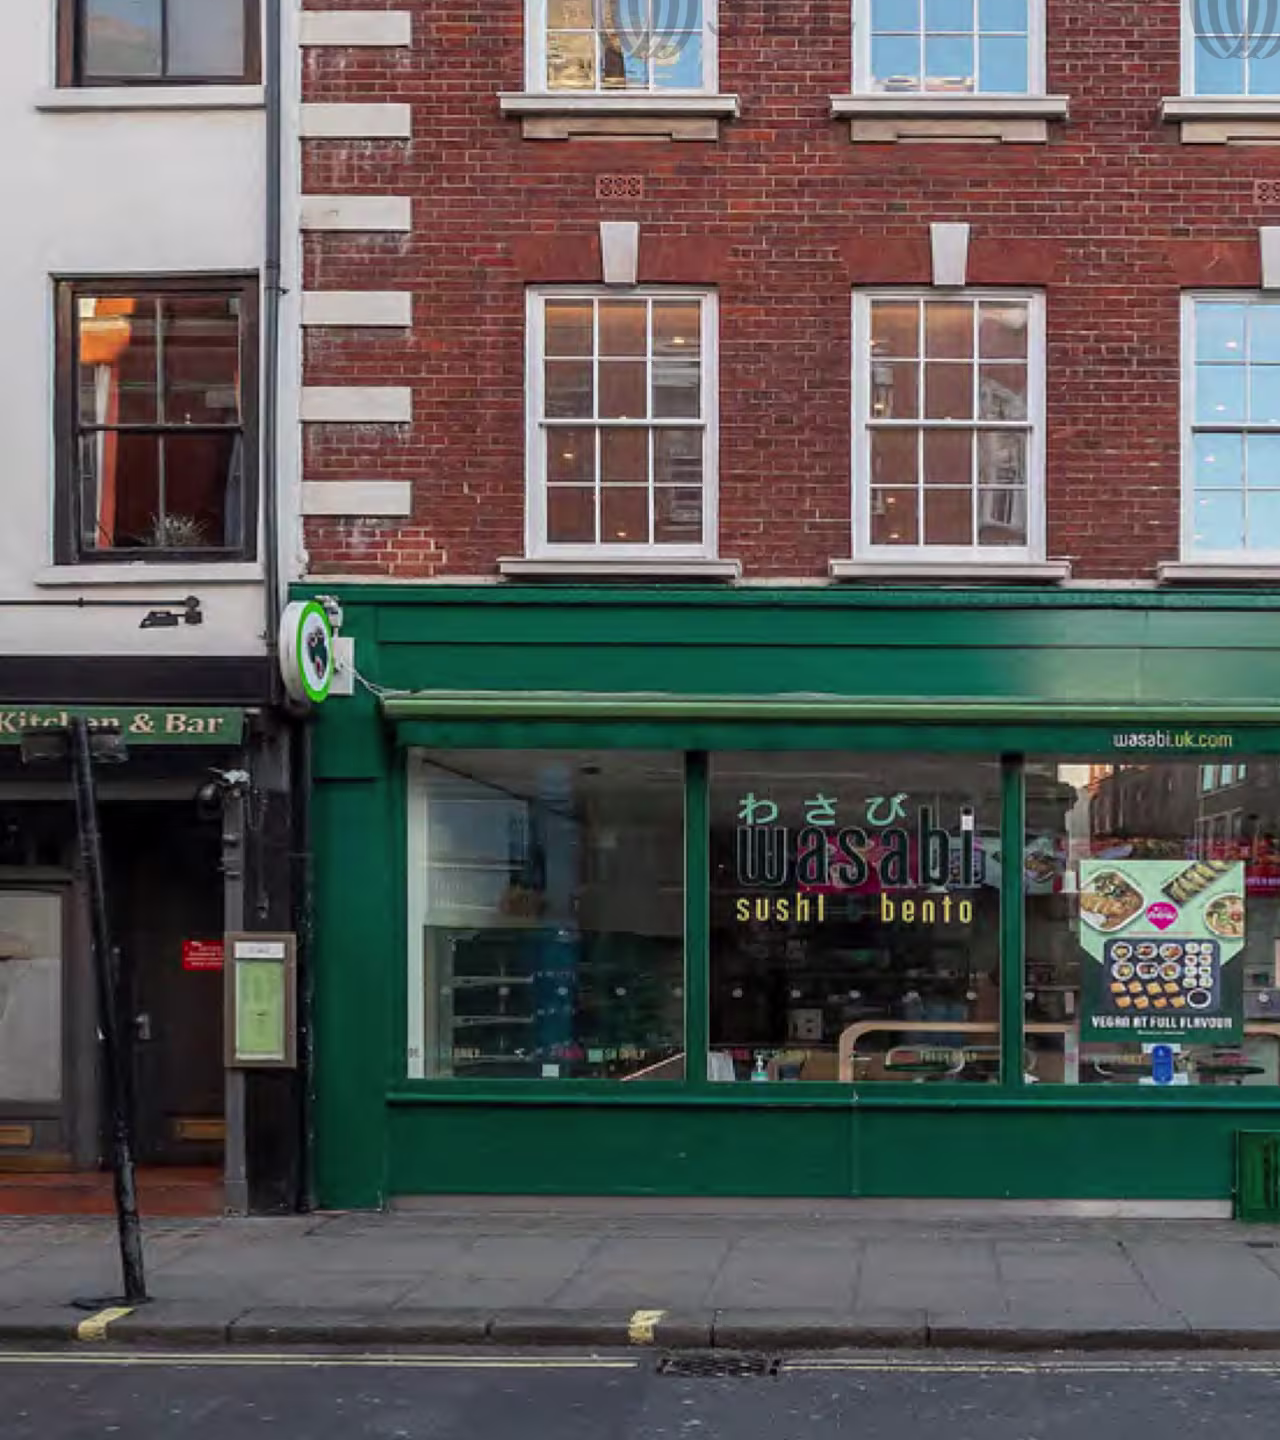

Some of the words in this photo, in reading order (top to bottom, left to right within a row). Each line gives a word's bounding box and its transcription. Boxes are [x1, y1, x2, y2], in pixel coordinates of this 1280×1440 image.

[129, 713, 155, 733] &
[165, 713, 223, 733] Bar
[1113, 729, 1233, 748] wasabi.uk.com
[738, 793, 909, 826] わさび
[737, 804, 980, 888] wasabi
[737, 892, 825, 922] sushi
[881, 892, 974, 923] bento
[1150, 1016, 1177, 1028] FULL
